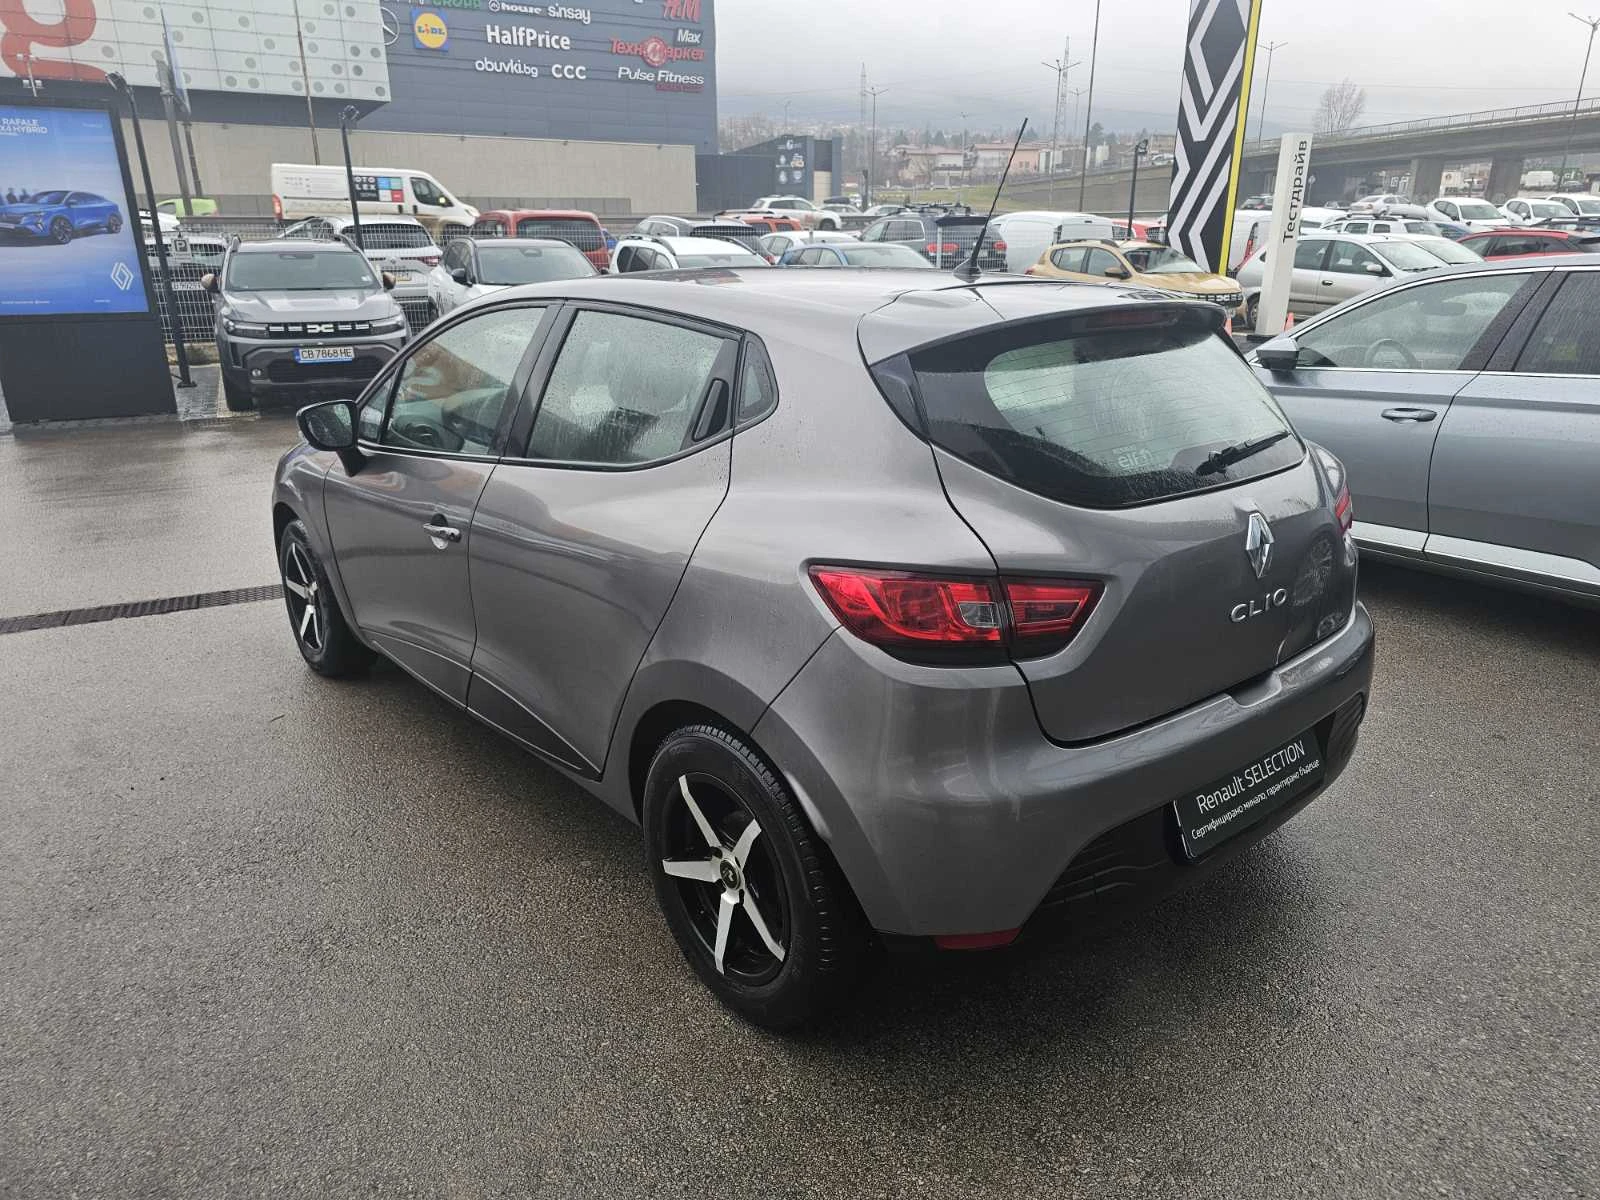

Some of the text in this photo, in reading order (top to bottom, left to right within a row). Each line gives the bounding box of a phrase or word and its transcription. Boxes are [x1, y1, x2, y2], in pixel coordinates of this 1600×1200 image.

[548, 3, 591, 24] sinsay
[486, 24, 571, 50] HalfPrice
[677, 29, 701, 43] Max
[475, 57, 538, 78] obuvki.bg
[551, 63, 587, 80] CCC
[618, 66, 704, 85] Pulse Fitness
[2, 118, 40, 126] RAFALE
[1282, 140, 1308, 243] Тестдрайв
[1230, 588, 1287, 623] CLIO
[1196, 740, 1306, 815] Renault SELECTION
[1191, 806, 1243, 841] Сертифицирано
